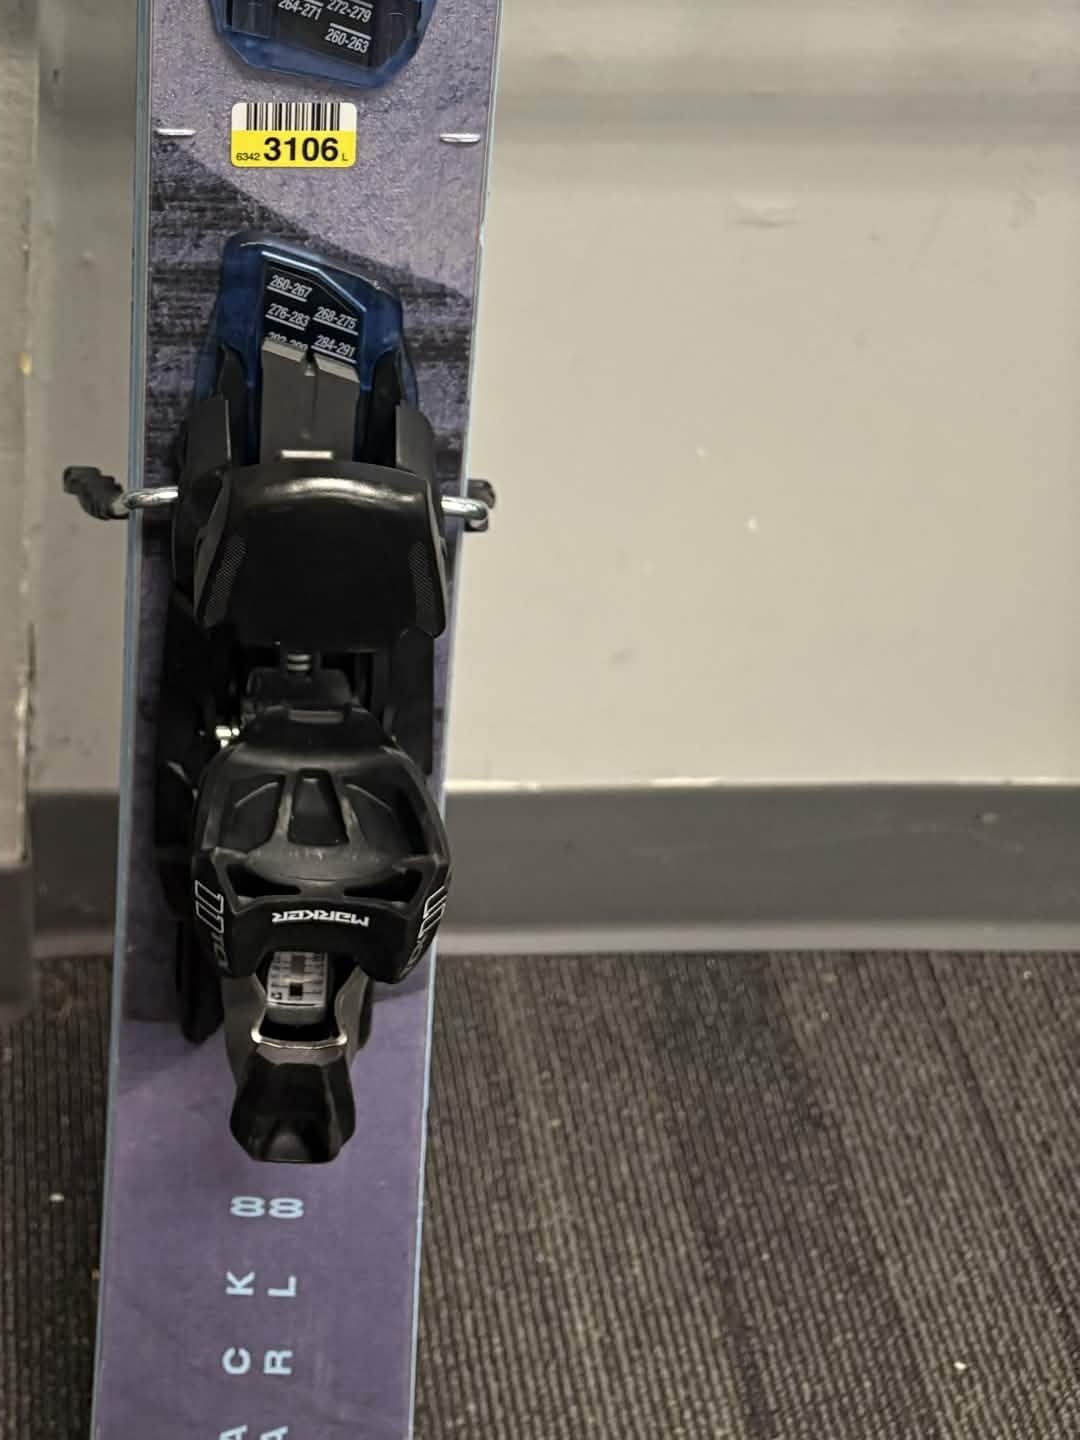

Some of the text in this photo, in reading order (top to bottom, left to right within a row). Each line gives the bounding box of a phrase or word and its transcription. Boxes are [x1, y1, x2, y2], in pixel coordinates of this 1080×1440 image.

[325, 28, 369, 53] 260-263
[264, 137, 339, 161] 3106
[270, 274, 312, 298] 260-267
[267, 303, 358, 329] 276-283 268-275
[314, 335, 356, 358] 284-291
[272, 910, 370, 928] MARKER
[230, 1196, 304, 1219] 88
